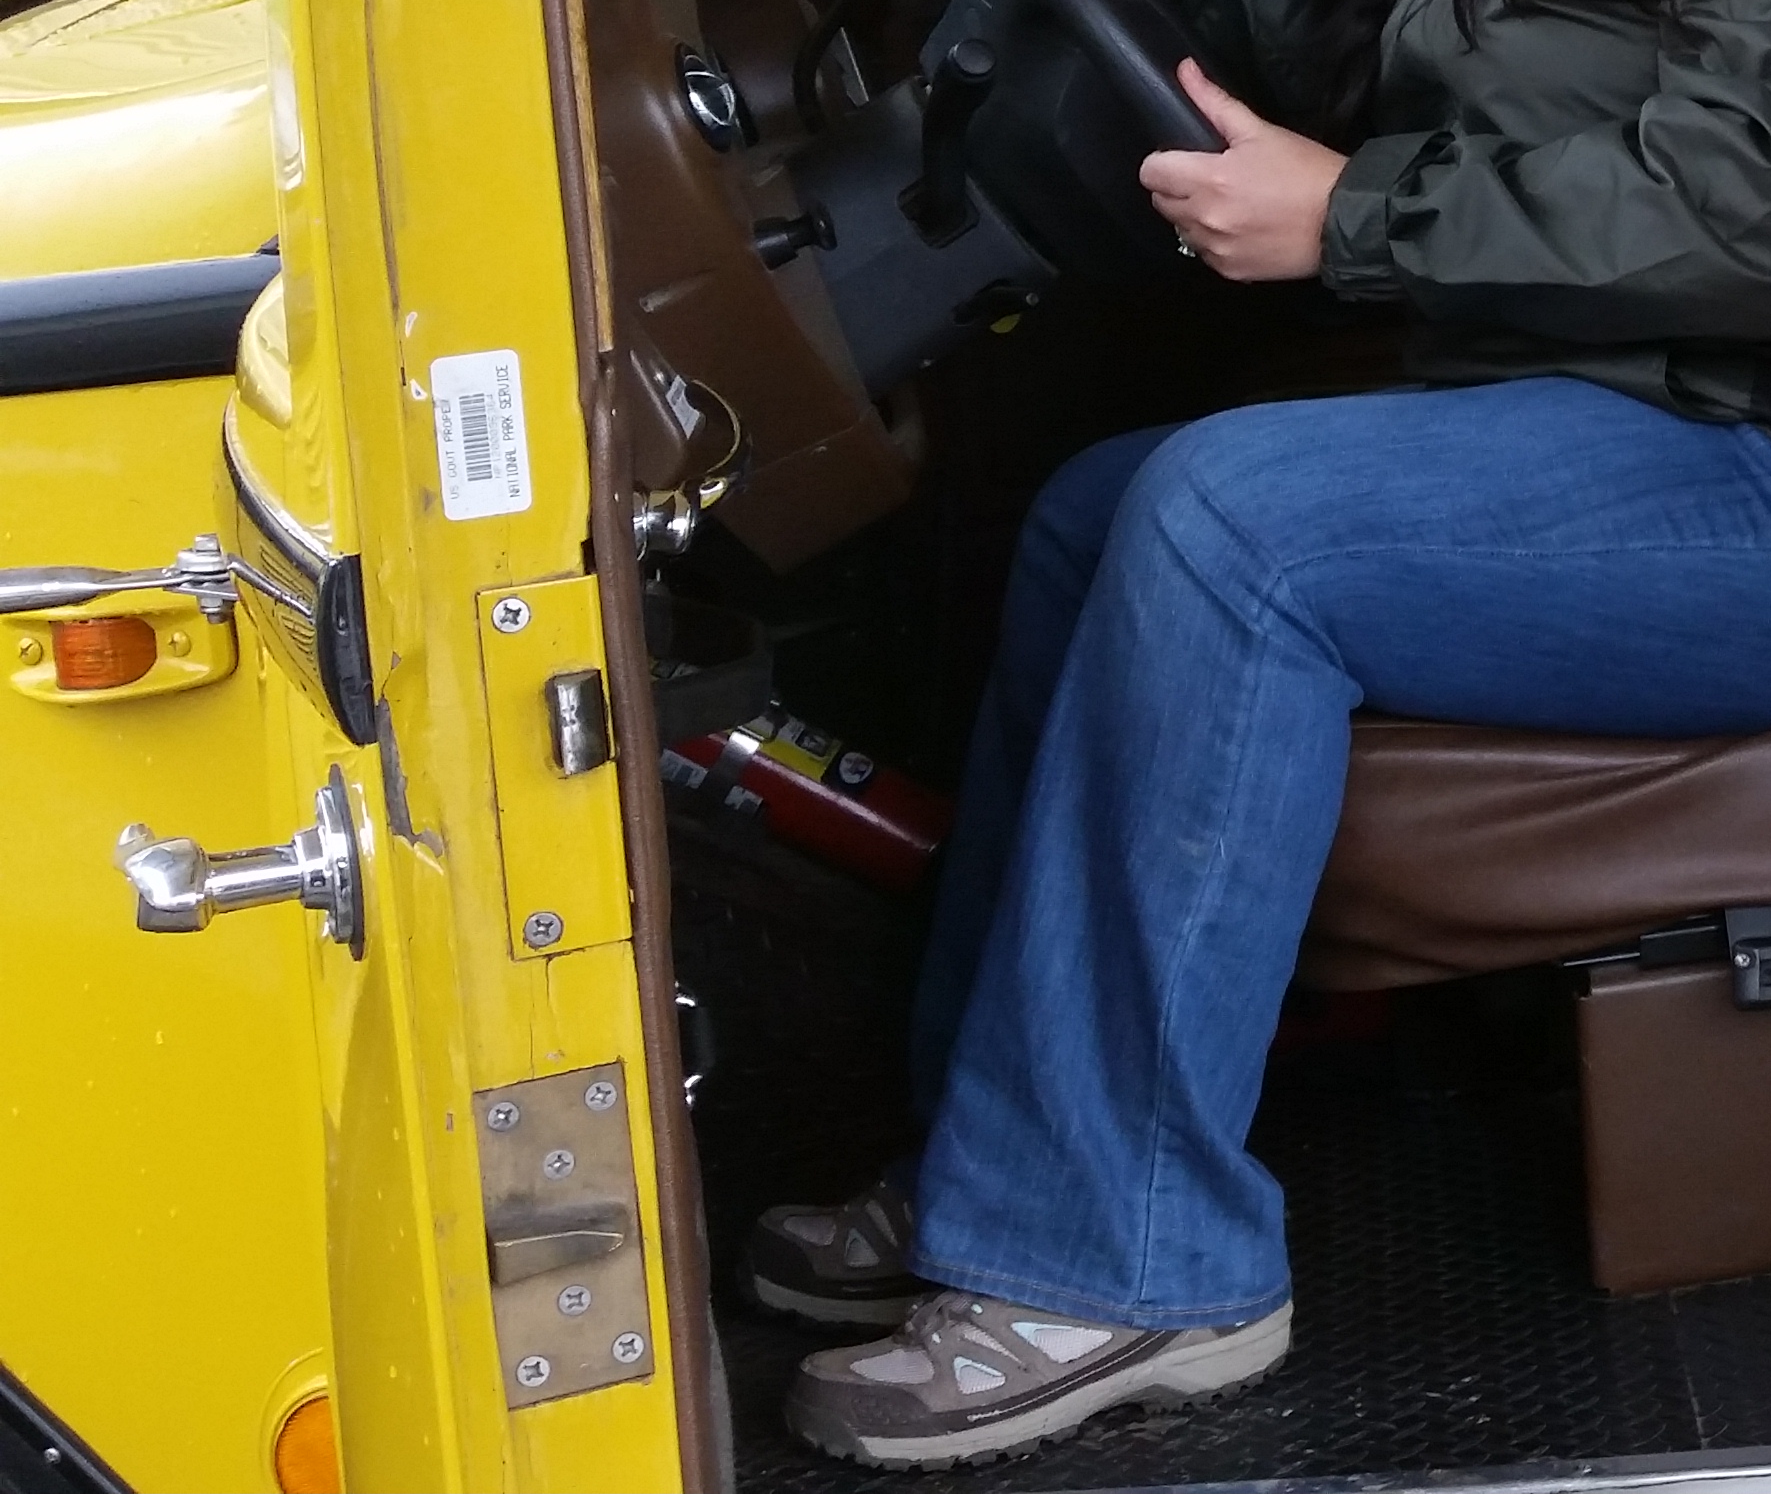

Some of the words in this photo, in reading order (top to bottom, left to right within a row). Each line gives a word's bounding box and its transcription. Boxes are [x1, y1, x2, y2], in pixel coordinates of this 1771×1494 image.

[495, 364, 512, 410] SERVICE
[502, 414, 515, 442] PARK
[505, 447, 521, 498] NATIONAL
